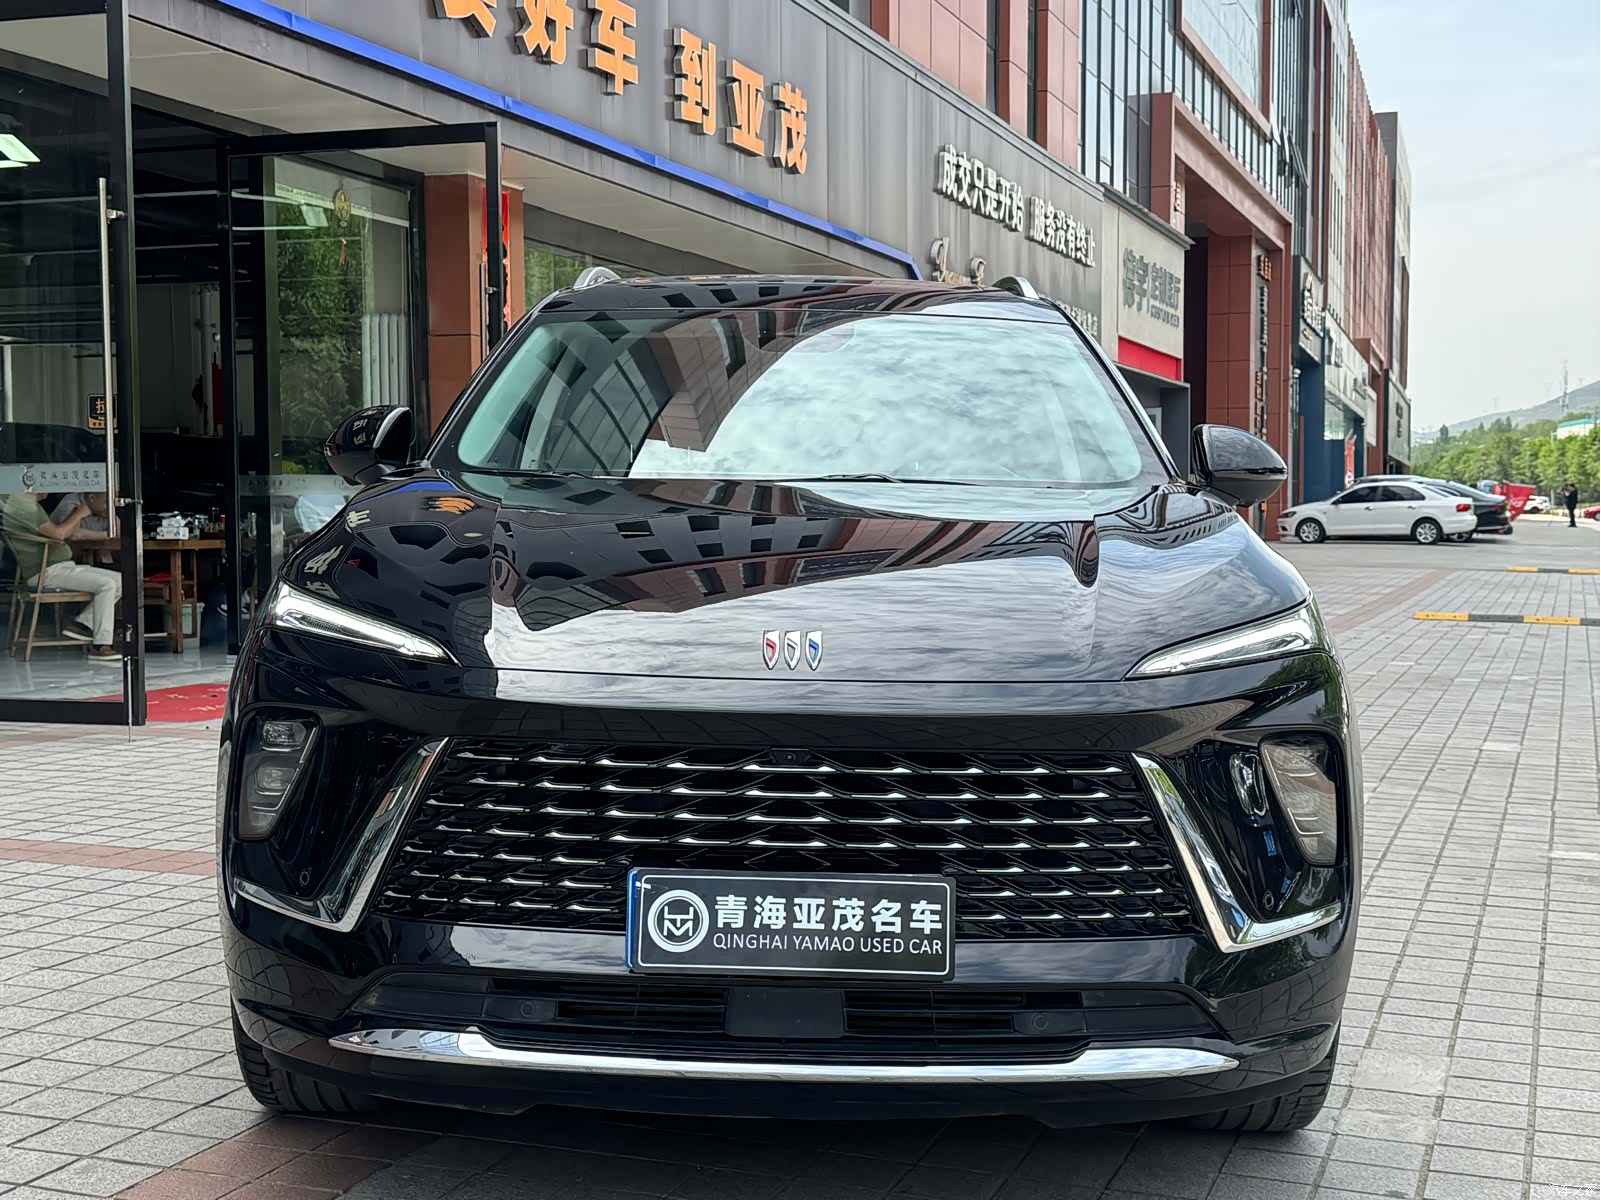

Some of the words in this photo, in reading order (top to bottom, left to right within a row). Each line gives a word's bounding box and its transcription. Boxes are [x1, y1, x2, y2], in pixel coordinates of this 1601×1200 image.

[675, 28, 808, 174] 到亚茂
[939, 144, 1024, 232] 成交只是开始
[1031, 196, 1096, 267] 服务没有终止
[713, 932, 788, 950] QINGHAI
[793, 935, 855, 952] YAMAO
[860, 937, 905, 953] USED
[909, 938, 943, 955] CAR
[715, 894, 943, 935] 青海亚茂名车
